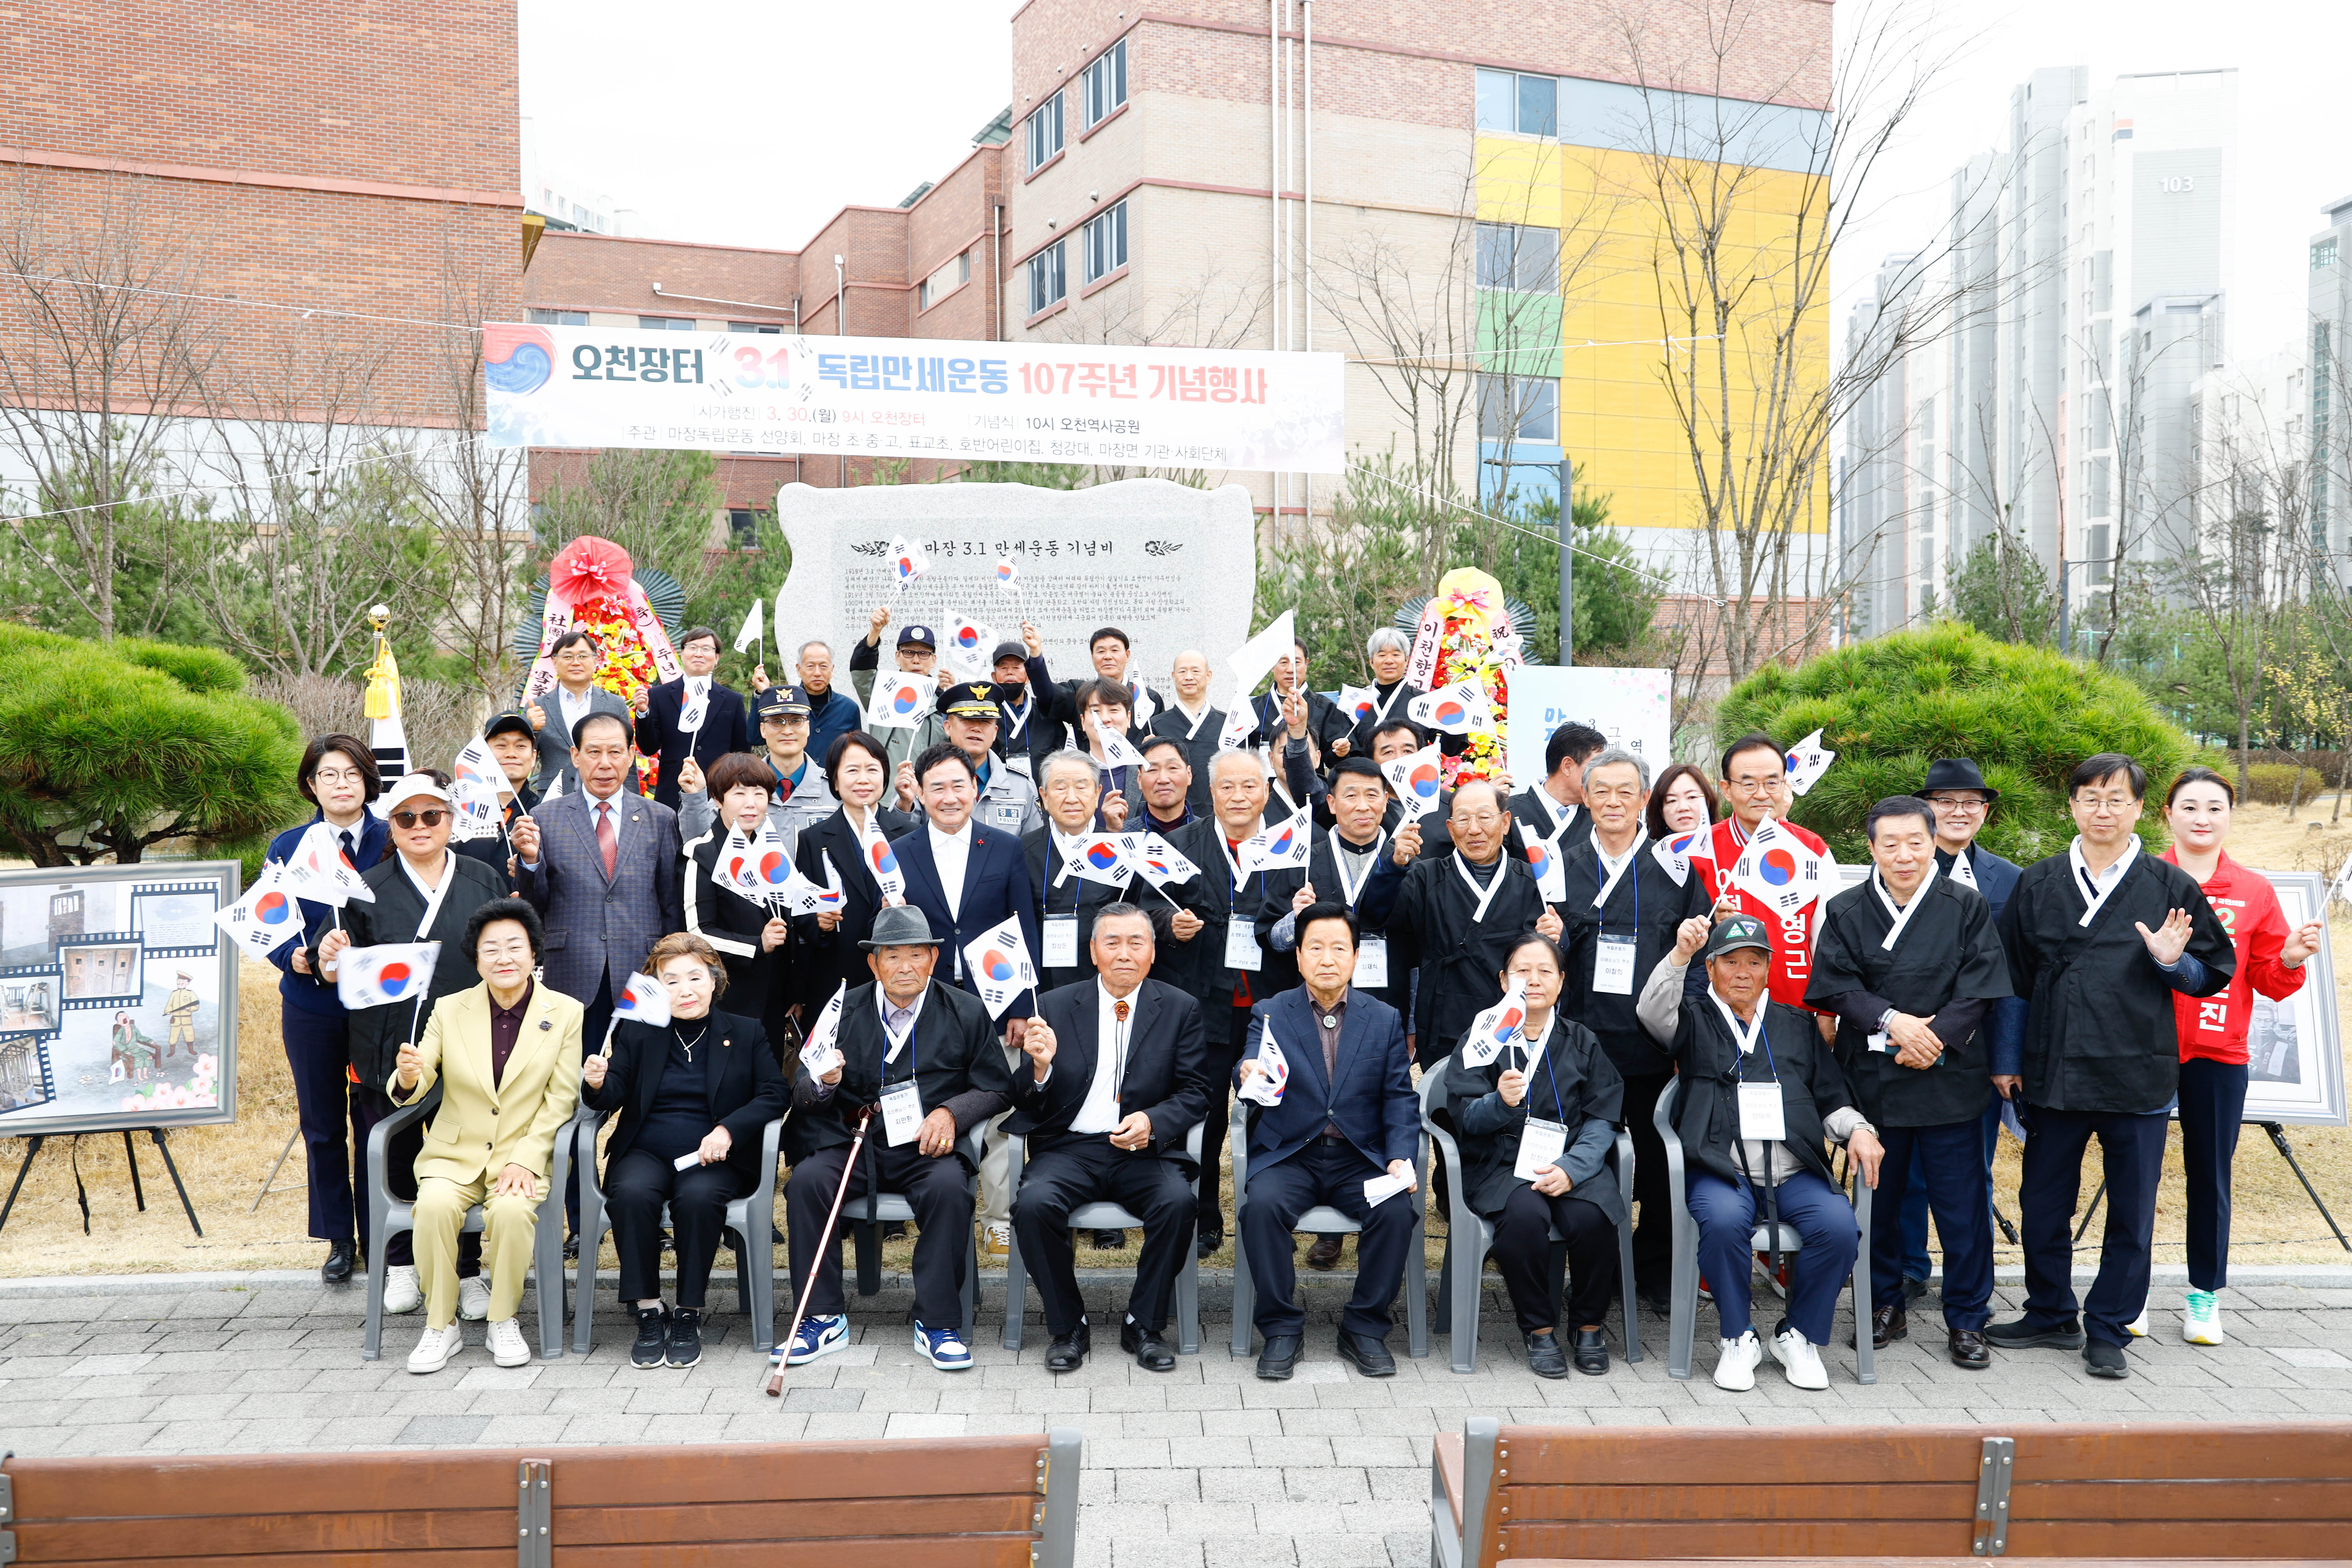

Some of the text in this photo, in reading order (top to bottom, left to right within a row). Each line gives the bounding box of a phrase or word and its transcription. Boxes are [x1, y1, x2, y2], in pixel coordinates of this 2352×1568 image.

[2160, 176, 2193, 192] 103
[572, 344, 1267, 405] 오천장터 3.1 독립만세운동 107주년 기념행사
[698, 405, 756, 420] 시가행진
[842, 410, 864, 424] 9시
[870, 411, 925, 426] 오천장터
[974, 415, 1140, 434] 기념식 10시 오천역사공원
[627, 426, 657, 440] 주관
[668, 426, 755, 444] 마장독립운동
[760, 429, 806, 445] 선양회,
[813, 431, 840, 446] 마장
[908, 435, 953, 451] 표교초,
[959, 436, 1044, 455] 호반어린이집,
[1050, 440, 1093, 456] 청강대,
[1099, 442, 1138, 458] 마장면
[924, 540, 1112, 557] 마장 3.1 만세운동 기념비
[999, 808, 1017, 817] 경찰
[2214, 907, 2236, 935] 2
